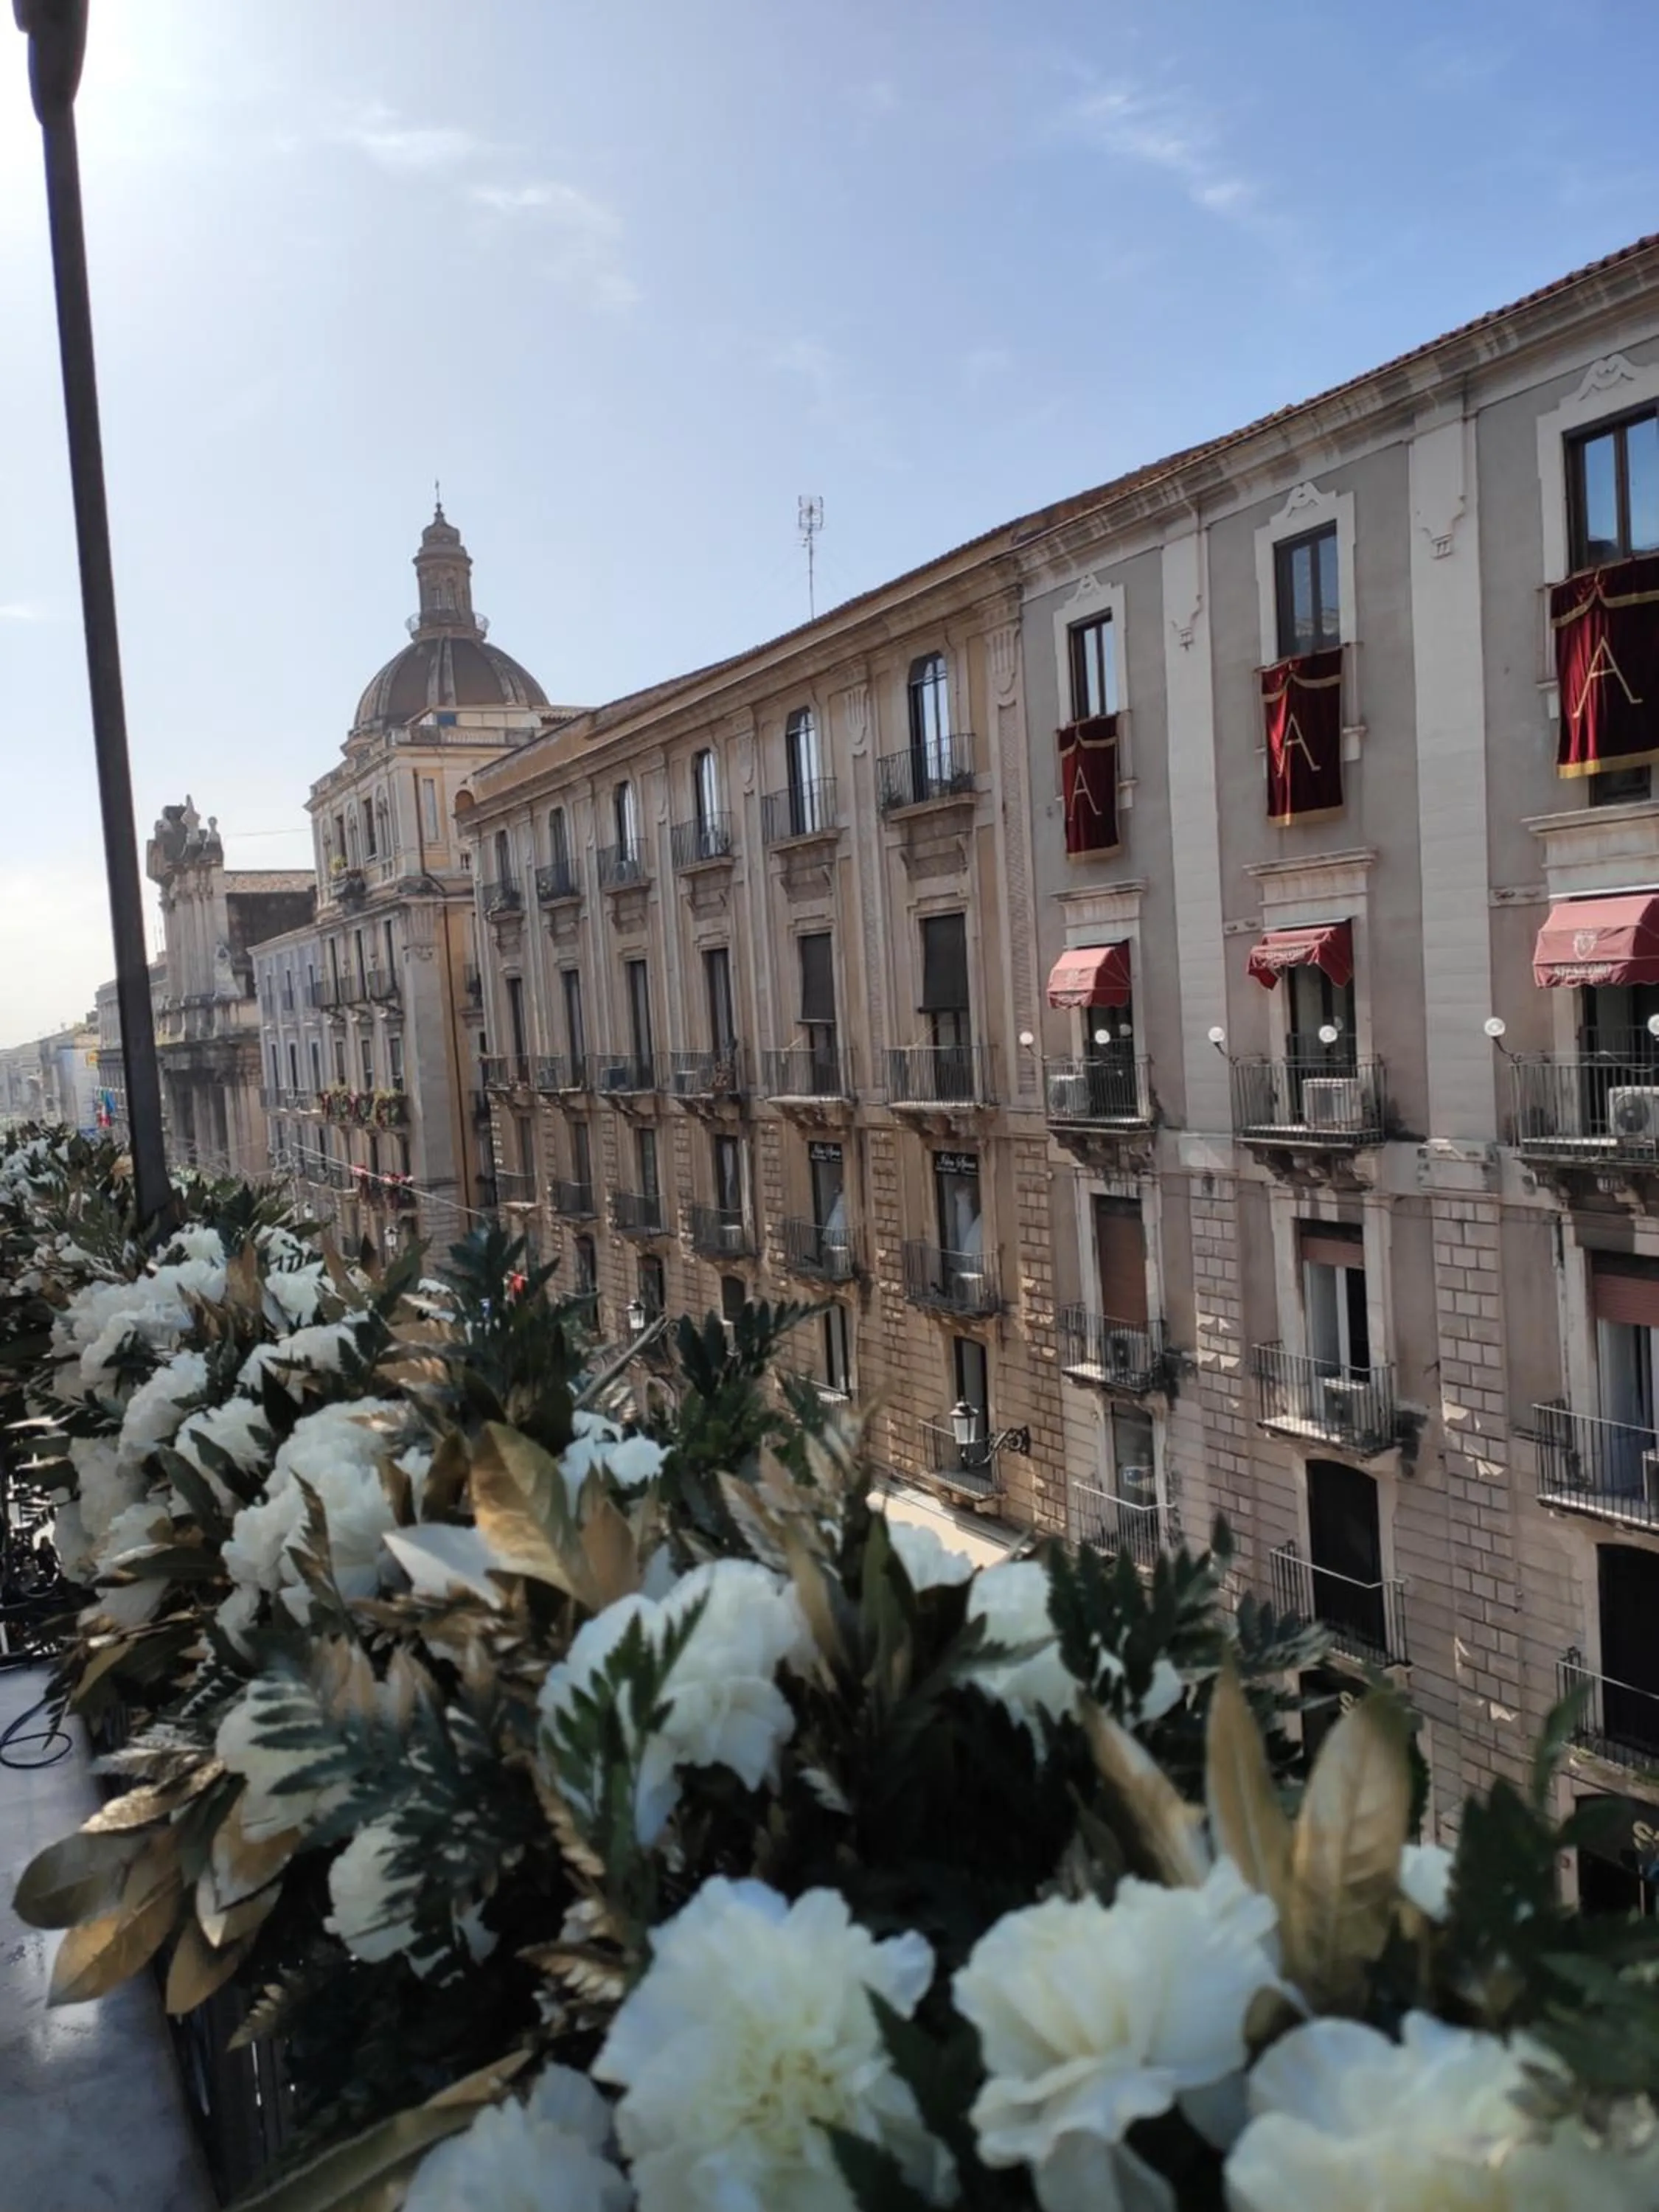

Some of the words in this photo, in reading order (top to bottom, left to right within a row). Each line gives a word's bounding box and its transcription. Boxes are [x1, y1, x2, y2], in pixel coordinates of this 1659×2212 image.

[1572, 636, 1644, 718] A
[1277, 712, 1321, 778] A
[1068, 765, 1102, 821] A
